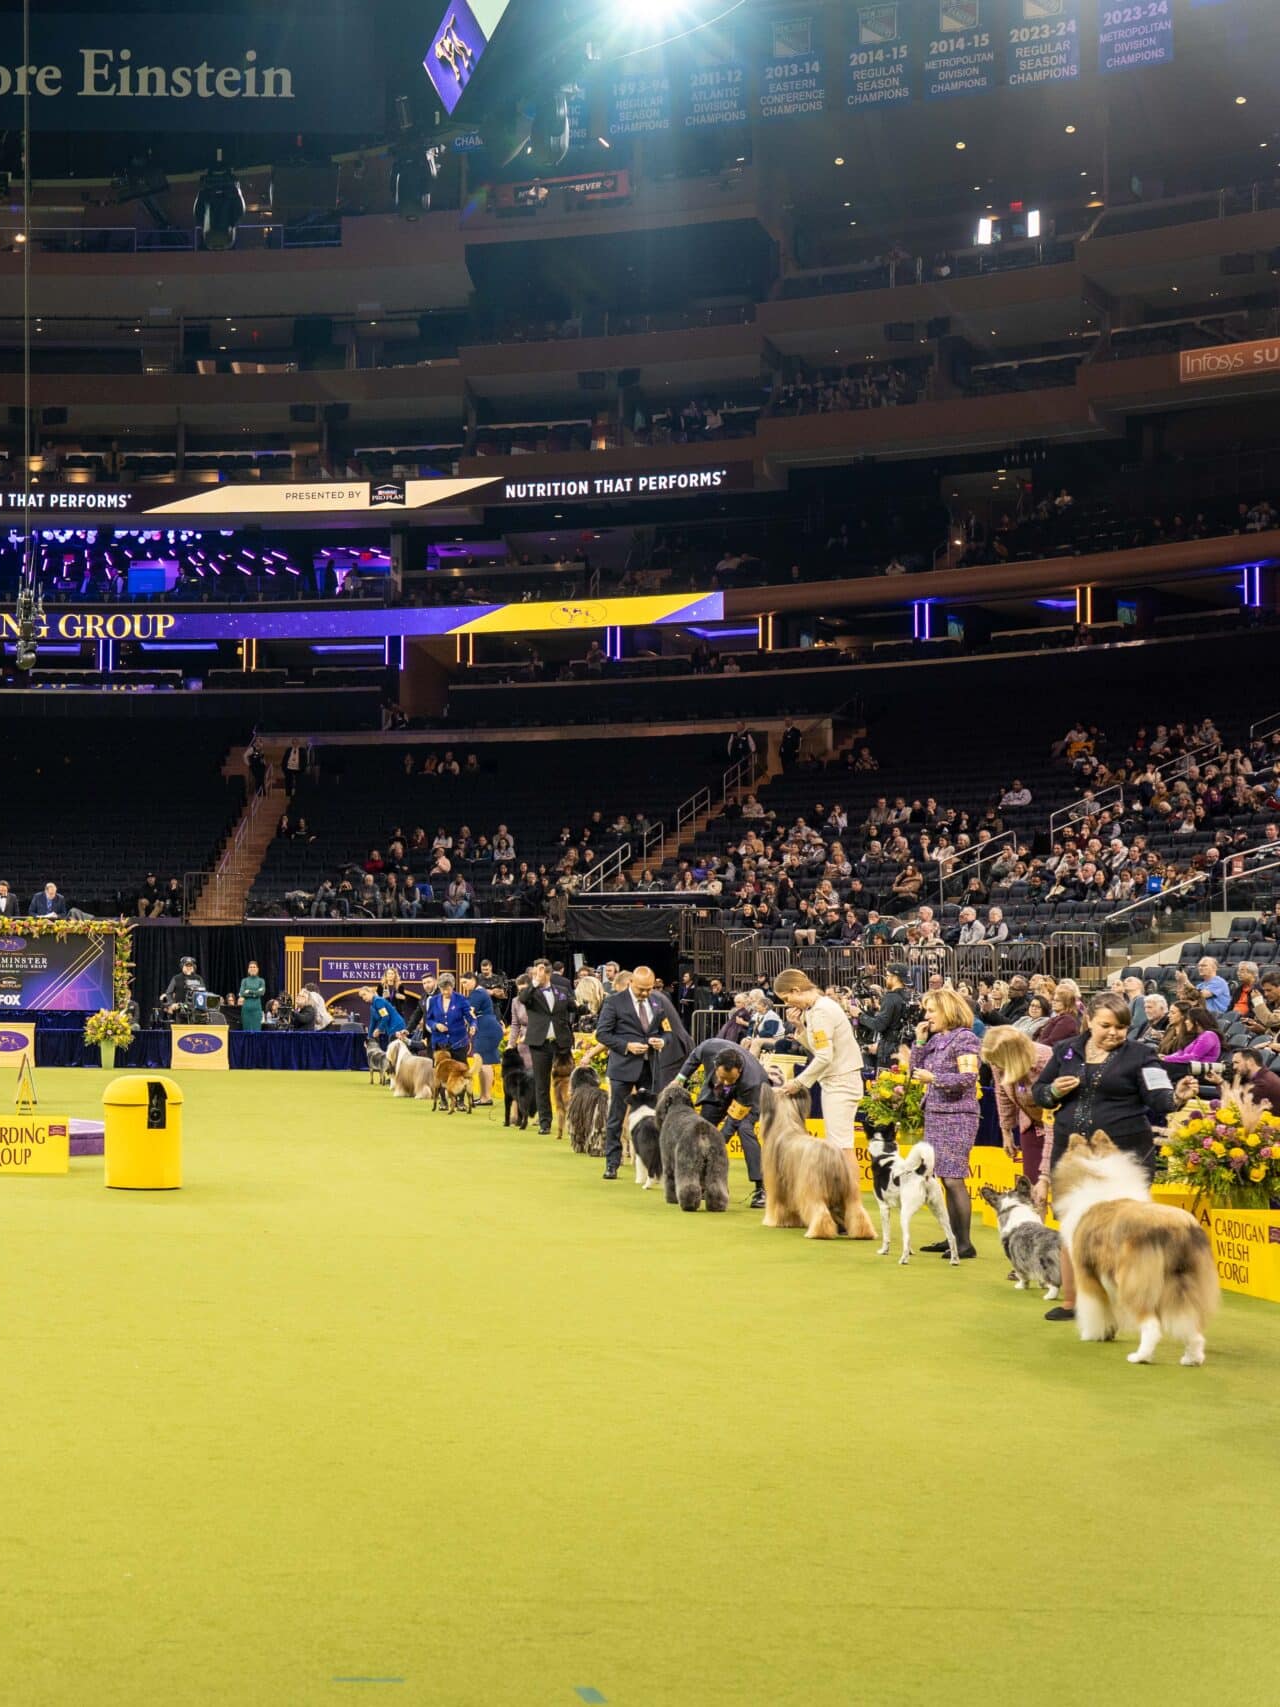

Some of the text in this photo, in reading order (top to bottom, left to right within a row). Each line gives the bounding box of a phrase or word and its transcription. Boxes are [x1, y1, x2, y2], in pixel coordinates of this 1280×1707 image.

[1103, 0, 1169, 26] 2023-24
[1009, 19, 1077, 43] 2023-24
[1099, 20, 1172, 44] METROPOLITAN
[928, 33, 990, 55] 2014-15
[1015, 40, 1071, 58] REGULAR
[1114, 36, 1157, 54] DIVISION
[849, 45, 908, 66] 2014-15
[924, 52, 994, 70] METROPOLITAN
[1019, 53, 1067, 71] SEASON
[1105, 47, 1165, 69] CHAMPIONS
[77, 49, 295, 98] Einstein
[689, 69, 743, 87] 2011-12
[765, 61, 820, 79] 2013-14
[853, 64, 904, 80] REGULAR
[939, 67, 979, 81] DIVISION
[1009, 64, 1078, 85] CHAMPIONS
[692, 87, 740, 101] ATLANTIC
[768, 78, 816, 93] EASTERN
[856, 78, 900, 92] SEASON
[930, 77, 987, 94] CHAMPIONS
[760, 89, 825, 106] CONFERENCE
[847, 87, 909, 105] CHAMPIONS
[619, 110, 660, 122] SEASON
[694, 100, 737, 114] DIVISION
[762, 101, 823, 117] CHAMPIONS
[610, 119, 669, 134] CHAMPIONS
[685, 111, 746, 126] CHAMPIONS
[1186, 352, 1244, 374] Infosys
[285, 490, 361, 500] PRESENTED BY
[505, 480, 589, 498] NUTRITION
[594, 478, 632, 494] THAT
[8, 494, 45, 507] THAT
[58, 613, 175, 639] GROUP
[328, 962, 429, 971] THE WESTMINSTER
[342, 970, 382, 979] KENNEL
[1215, 1218, 1265, 1243] CARDIGAN
[1216, 1240, 1250, 1262] WELSH
[1217, 1261, 1249, 1284] CORGI
